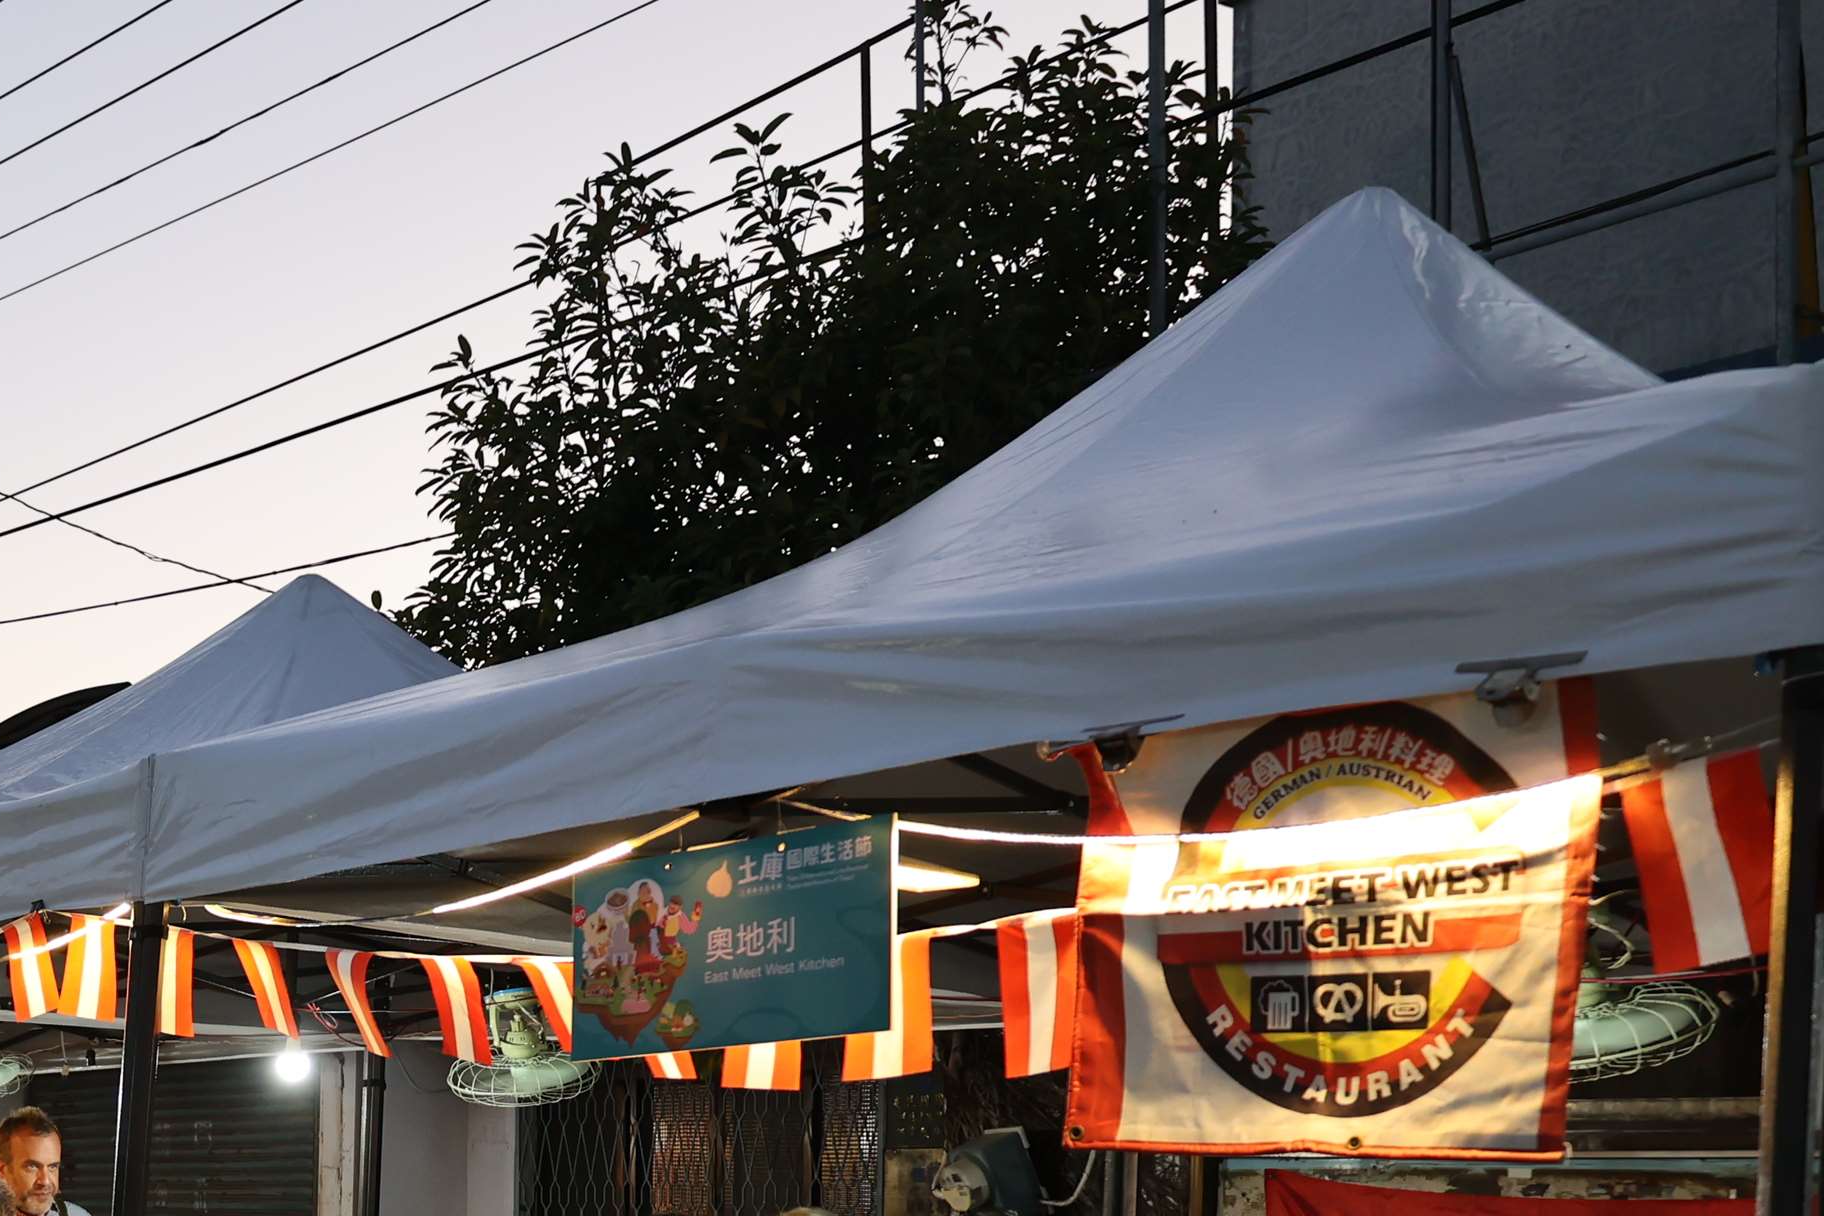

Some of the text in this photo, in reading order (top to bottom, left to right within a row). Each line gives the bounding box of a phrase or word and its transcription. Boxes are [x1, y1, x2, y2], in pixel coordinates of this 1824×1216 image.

[1226, 726, 1455, 810] 德國/奧地利料理
[1253, 766, 1324, 821] GERMAN
[1336, 763, 1434, 802] AUSTRIAN
[1402, 859, 1523, 900] WEST
[705, 916, 797, 964] 奧地利
[1244, 911, 1432, 955] KITCHEN
[704, 955, 846, 985] East Meet West Kitchen
[1207, 1004, 1476, 1106] RESTAURANT
